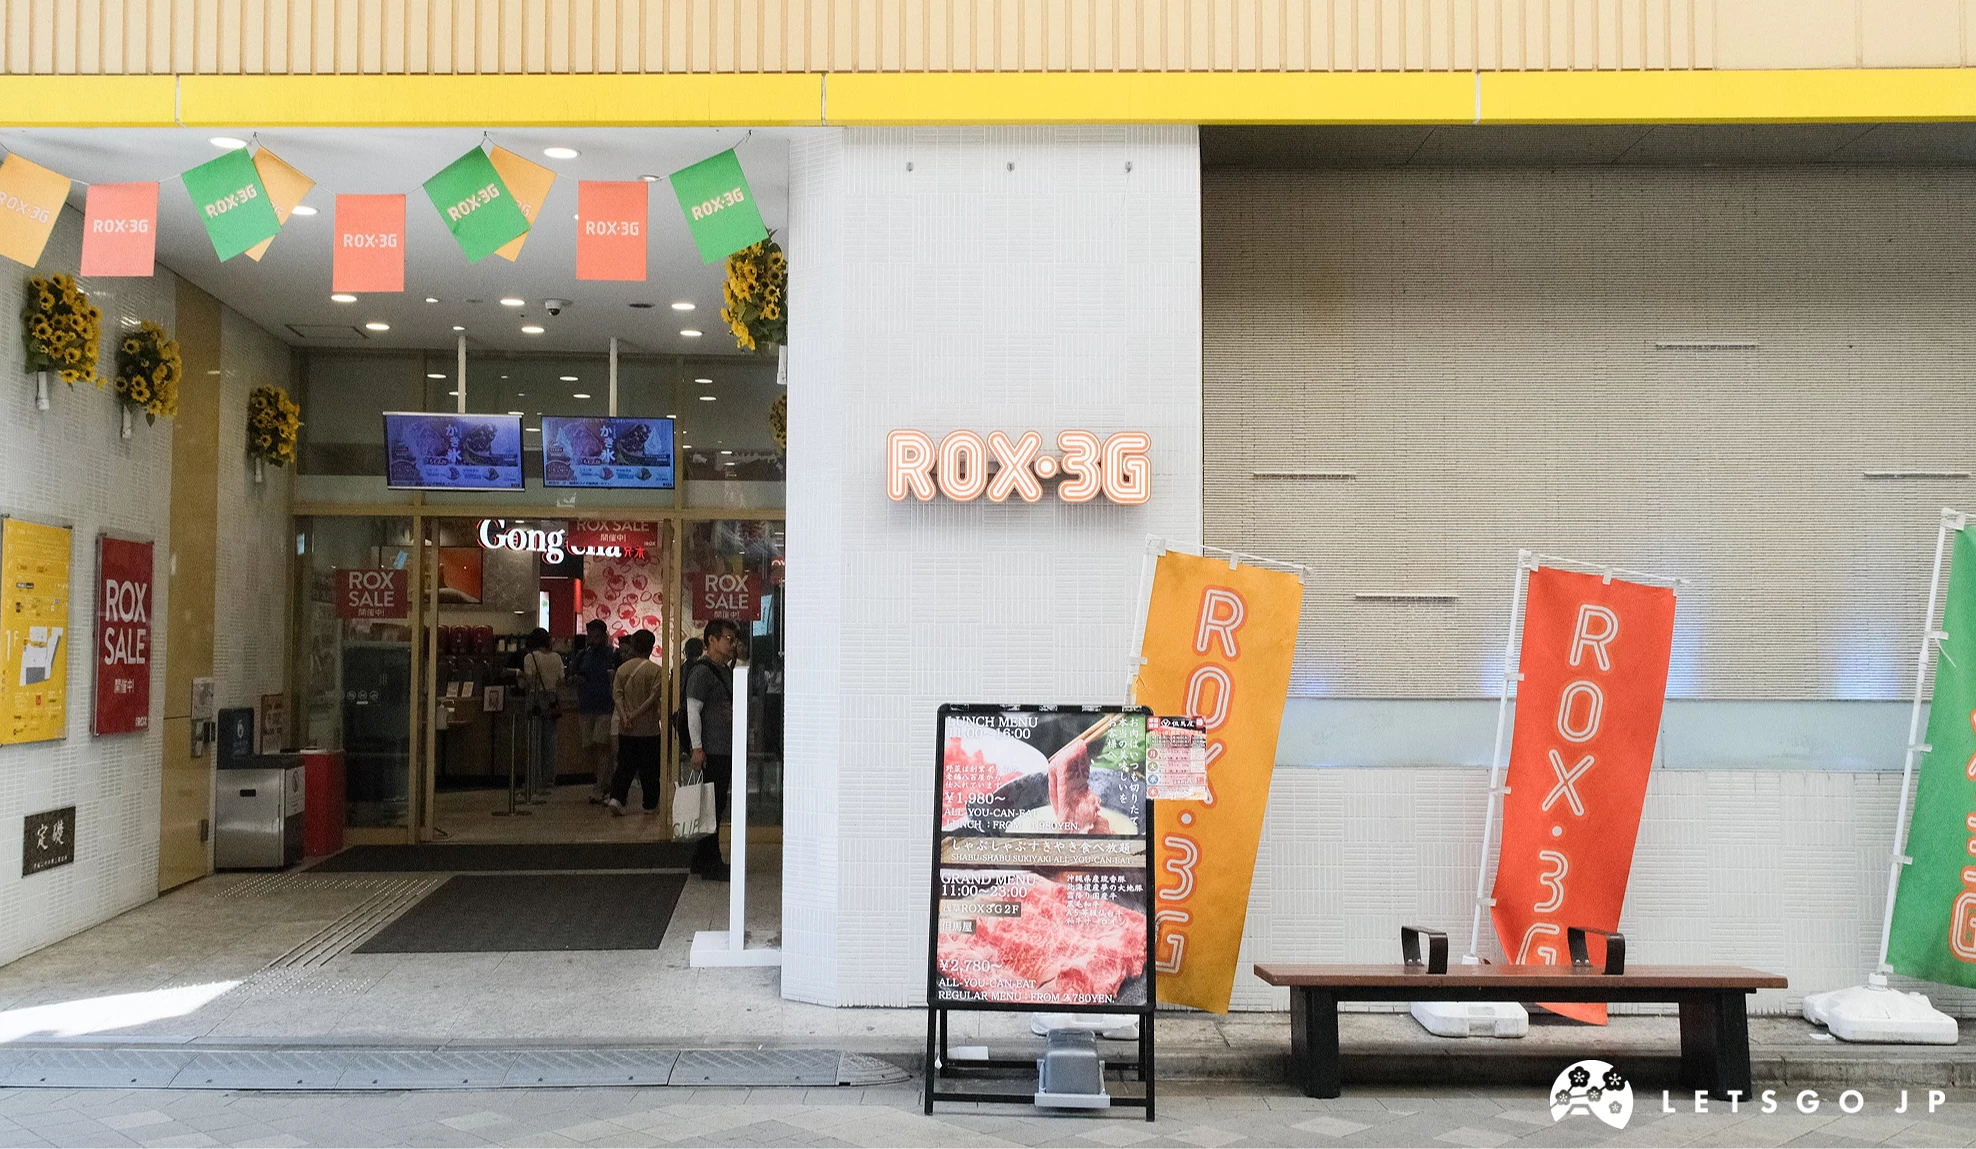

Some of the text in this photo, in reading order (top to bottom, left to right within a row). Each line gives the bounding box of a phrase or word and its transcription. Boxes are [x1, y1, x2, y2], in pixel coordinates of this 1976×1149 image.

[577, 520, 649, 531] ROX SALE
[479, 519, 566, 564] Gong
[349, 571, 394, 589] ROX
[705, 574, 748, 592] ROX
[105, 579, 147, 623] ROX
[349, 591, 394, 607] SALE
[705, 593, 749, 609] SALE
[104, 626, 146, 665] SALE
[947, 715, 1039, 728] LUNCH MENU
[1107, 718, 1117, 759] お客様へ
[1129, 718, 1140, 826] お肉はいつも切りたて
[993, 821, 1023, 830] FROM
[37, 819, 64, 850] 定礎
[952, 839, 1131, 854] しゃぶしゃぶすきやき食べ放題
[951, 853, 1011, 863] SHABU-SHABU
[940, 874, 1036, 886] GRAND MENU
[938, 990, 988, 1001] REGULAR
[991, 991, 1022, 1001] MENU
[1030, 993, 1060, 1002] FROM
